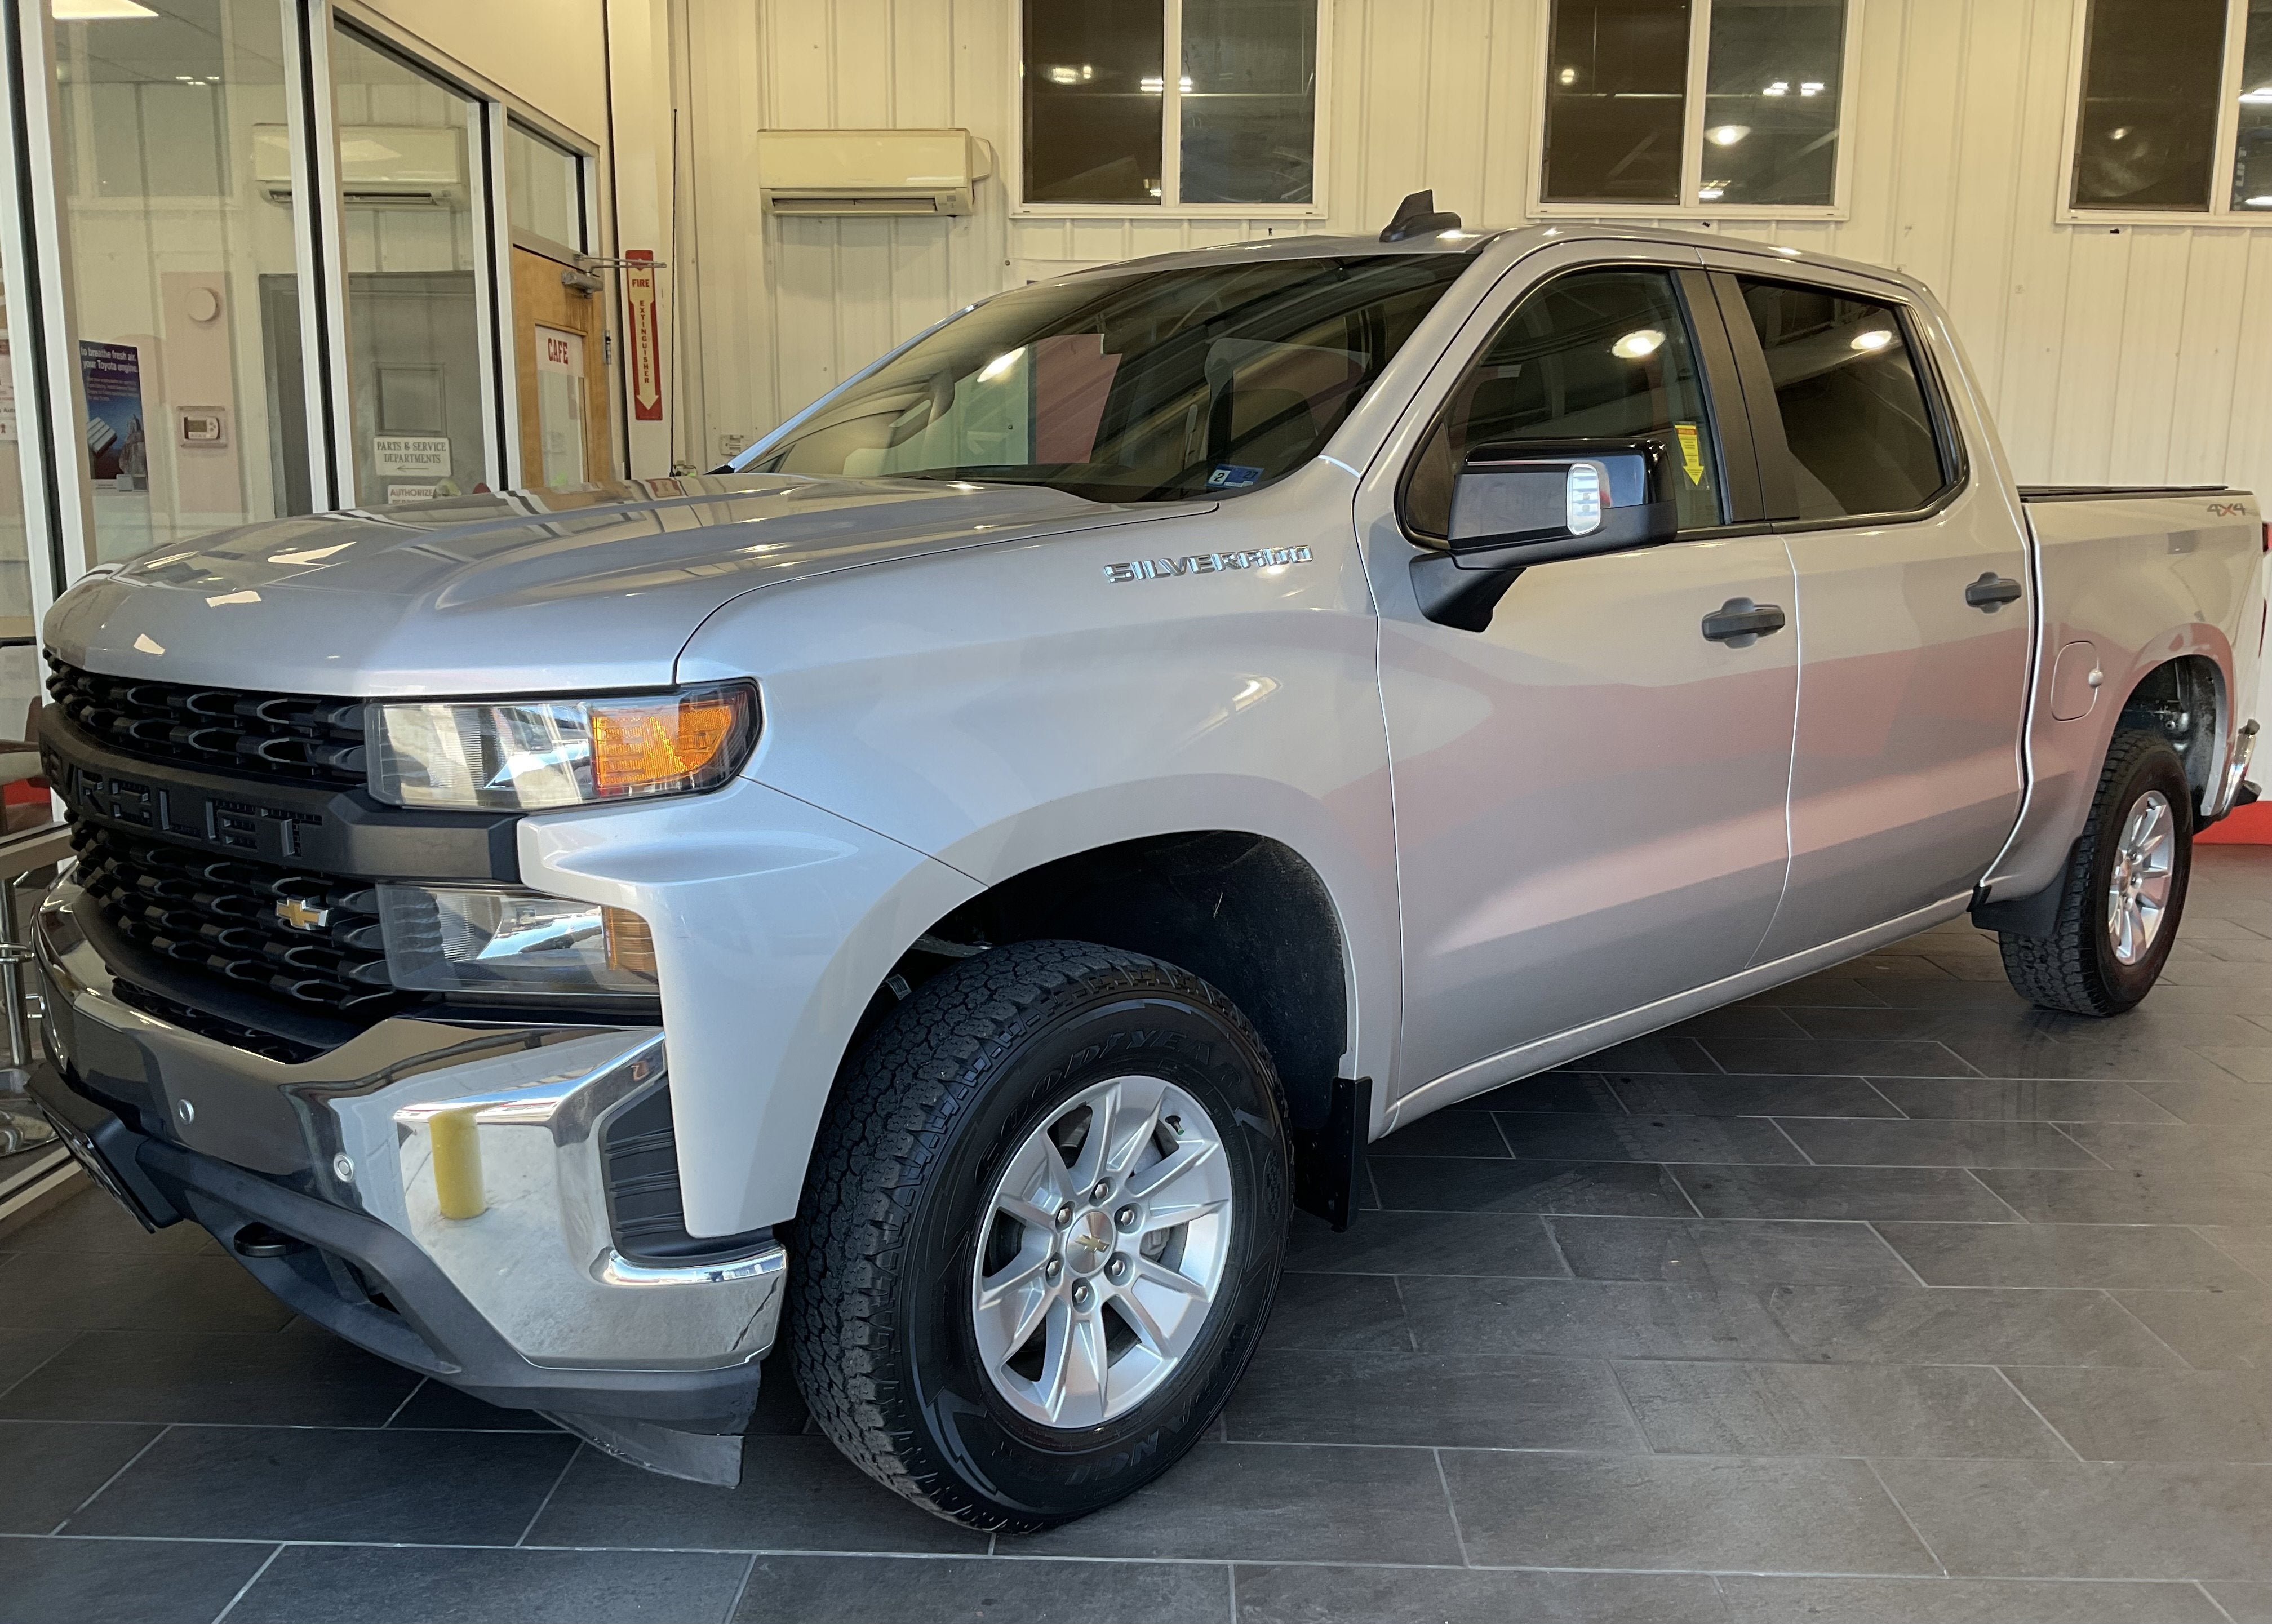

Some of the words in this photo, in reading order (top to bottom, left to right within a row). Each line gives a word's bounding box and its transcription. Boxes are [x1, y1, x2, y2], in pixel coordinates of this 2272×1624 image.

[632, 279, 650, 287] FIRE
[640, 300, 650, 384] EXTINGUISHER
[88, 347, 112, 359] breathe
[112, 350, 127, 361] fresh
[548, 338, 569, 365] CAFE
[83, 361, 96, 370] your
[97, 360, 117, 372] Toyota
[377, 441, 402, 451] PARTS
[404, 442, 410, 451] &
[412, 442, 446, 451] SERVICE
[384, 453, 441, 463] DEPARTMENTS
[1214, 472, 1225, 482] 2
[1103, 545, 1314, 583] SILVERADO
